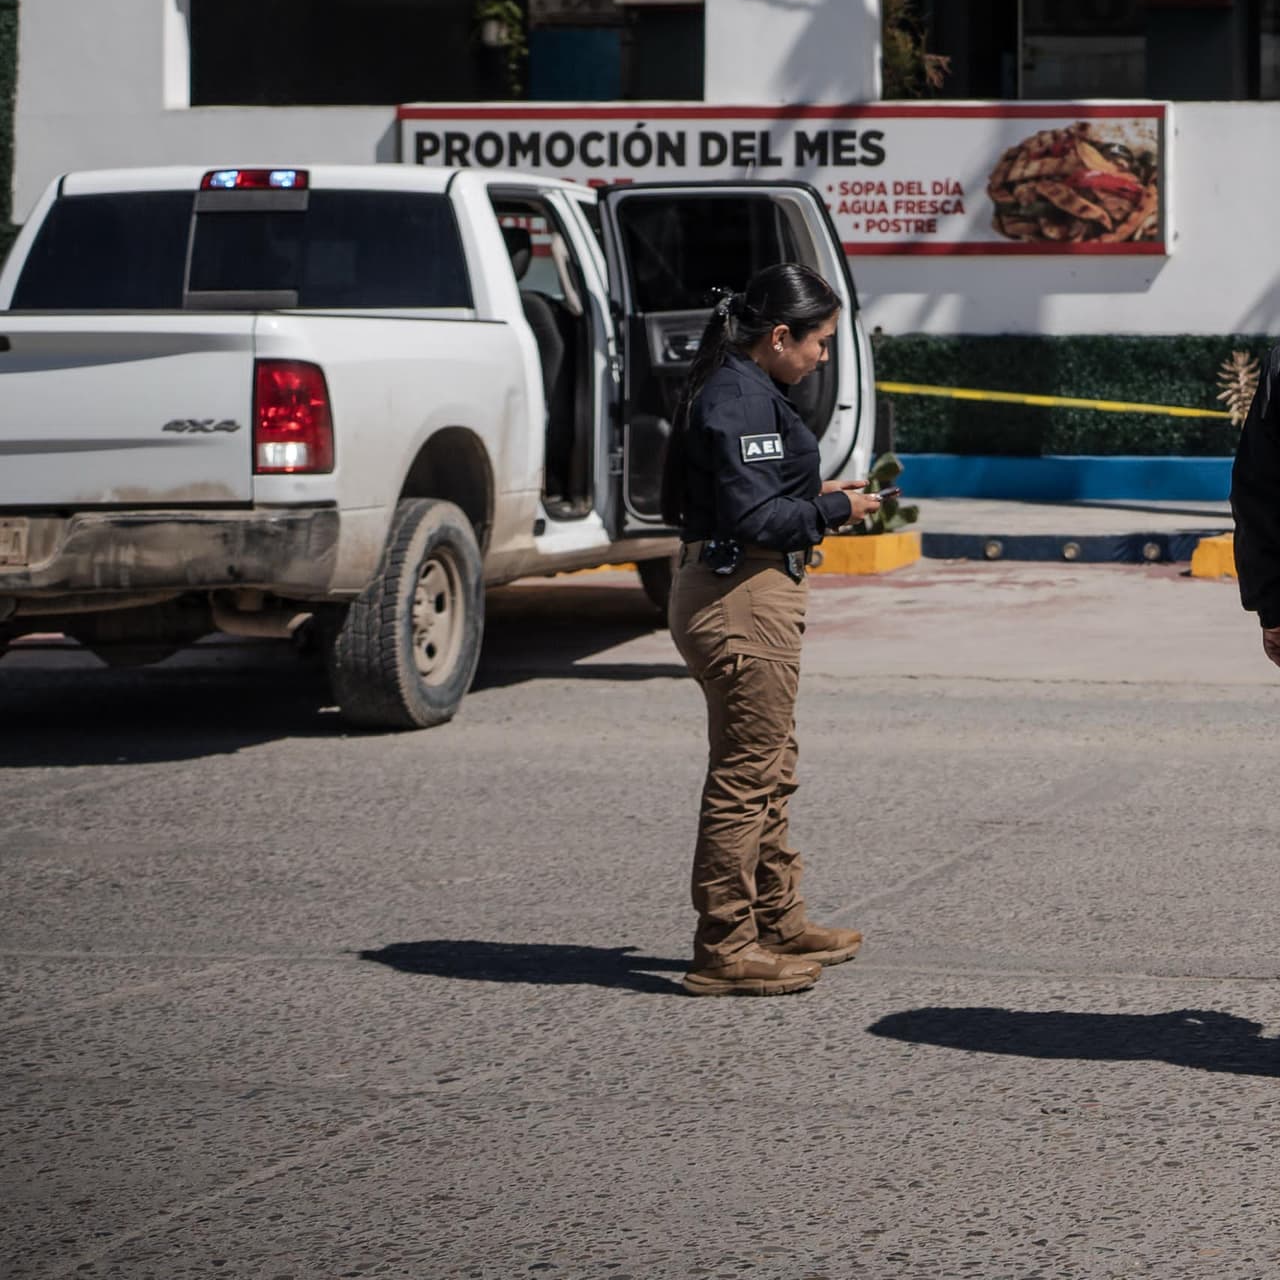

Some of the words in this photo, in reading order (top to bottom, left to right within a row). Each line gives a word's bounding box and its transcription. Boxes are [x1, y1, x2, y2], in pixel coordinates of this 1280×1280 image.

[415, 122, 686, 167] PROMOCIÓN
[700, 131, 782, 167] DEL
[794, 130, 886, 167] MES
[839, 182, 887, 196] SOPA
[893, 182, 926, 196] DEL
[932, 179, 964, 195] DÍA
[838, 200, 888, 215] AGUA
[894, 200, 965, 215] FRESCA
[865, 218, 937, 233] POSTRE
[747, 440, 782, 456] AEI
